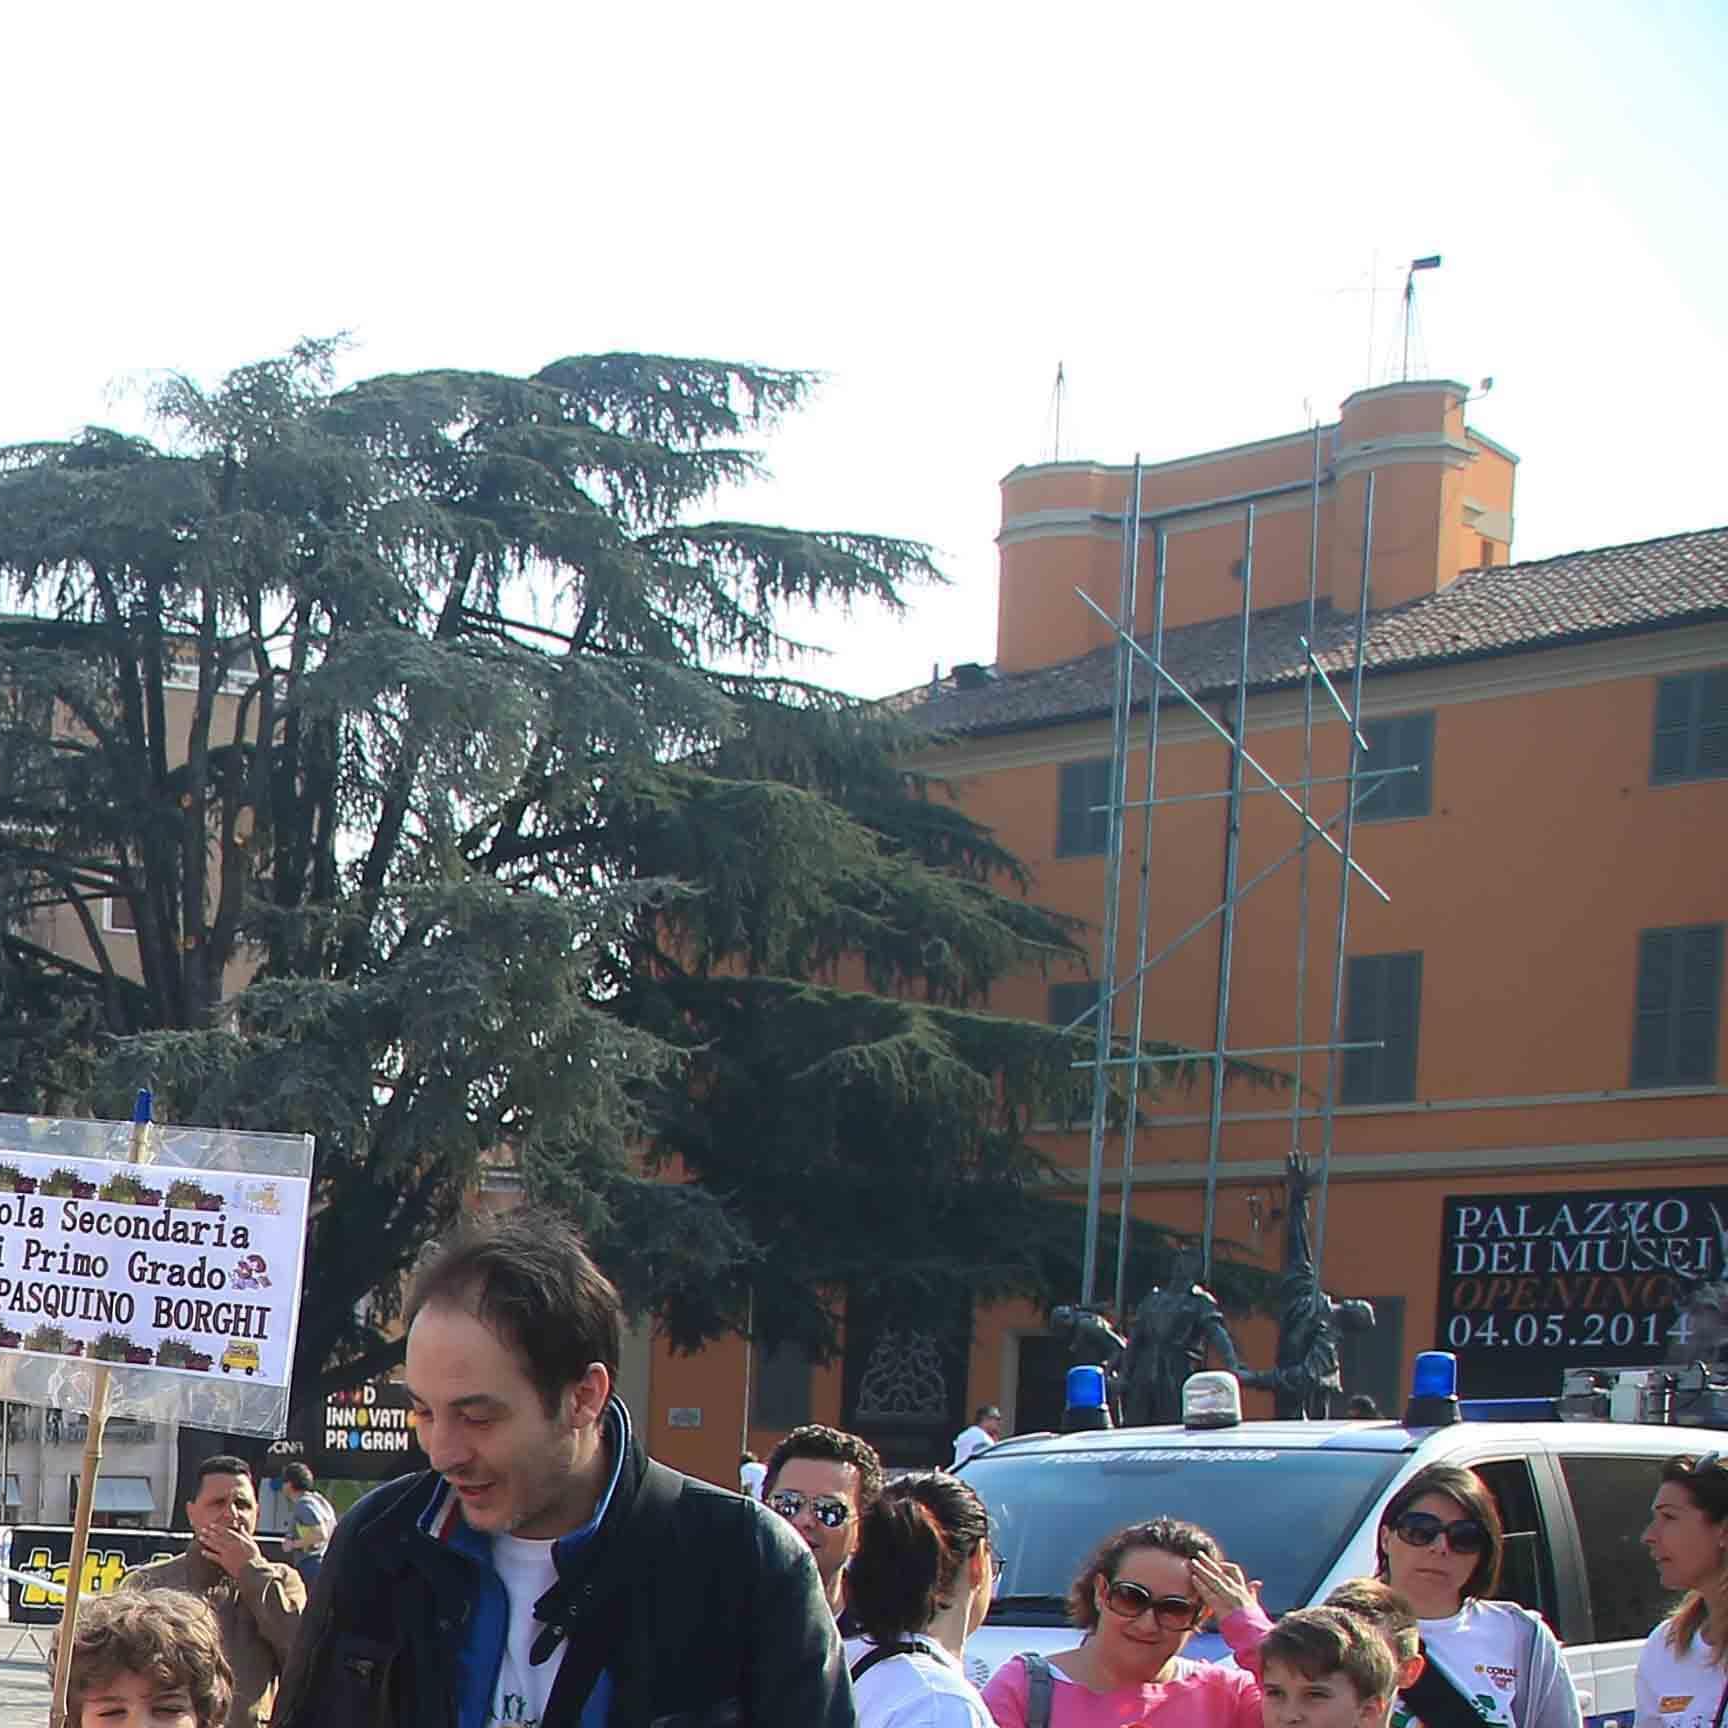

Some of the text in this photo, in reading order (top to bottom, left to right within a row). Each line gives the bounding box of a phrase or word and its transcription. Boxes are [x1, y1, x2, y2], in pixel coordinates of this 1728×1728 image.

[61, 1202, 250, 1249] Secondaria
[1454, 1200, 1689, 1239] PALAZZO
[21, 1239, 108, 1279] Primo
[128, 1251, 226, 1290] Grado
[1453, 1237, 1713, 1275] DEI MUSEI
[152, 1296, 271, 1340] BORGHI
[1448, 1313, 1693, 1347] 04.05.2014
[325, 1430, 408, 1451] PROGRAM
